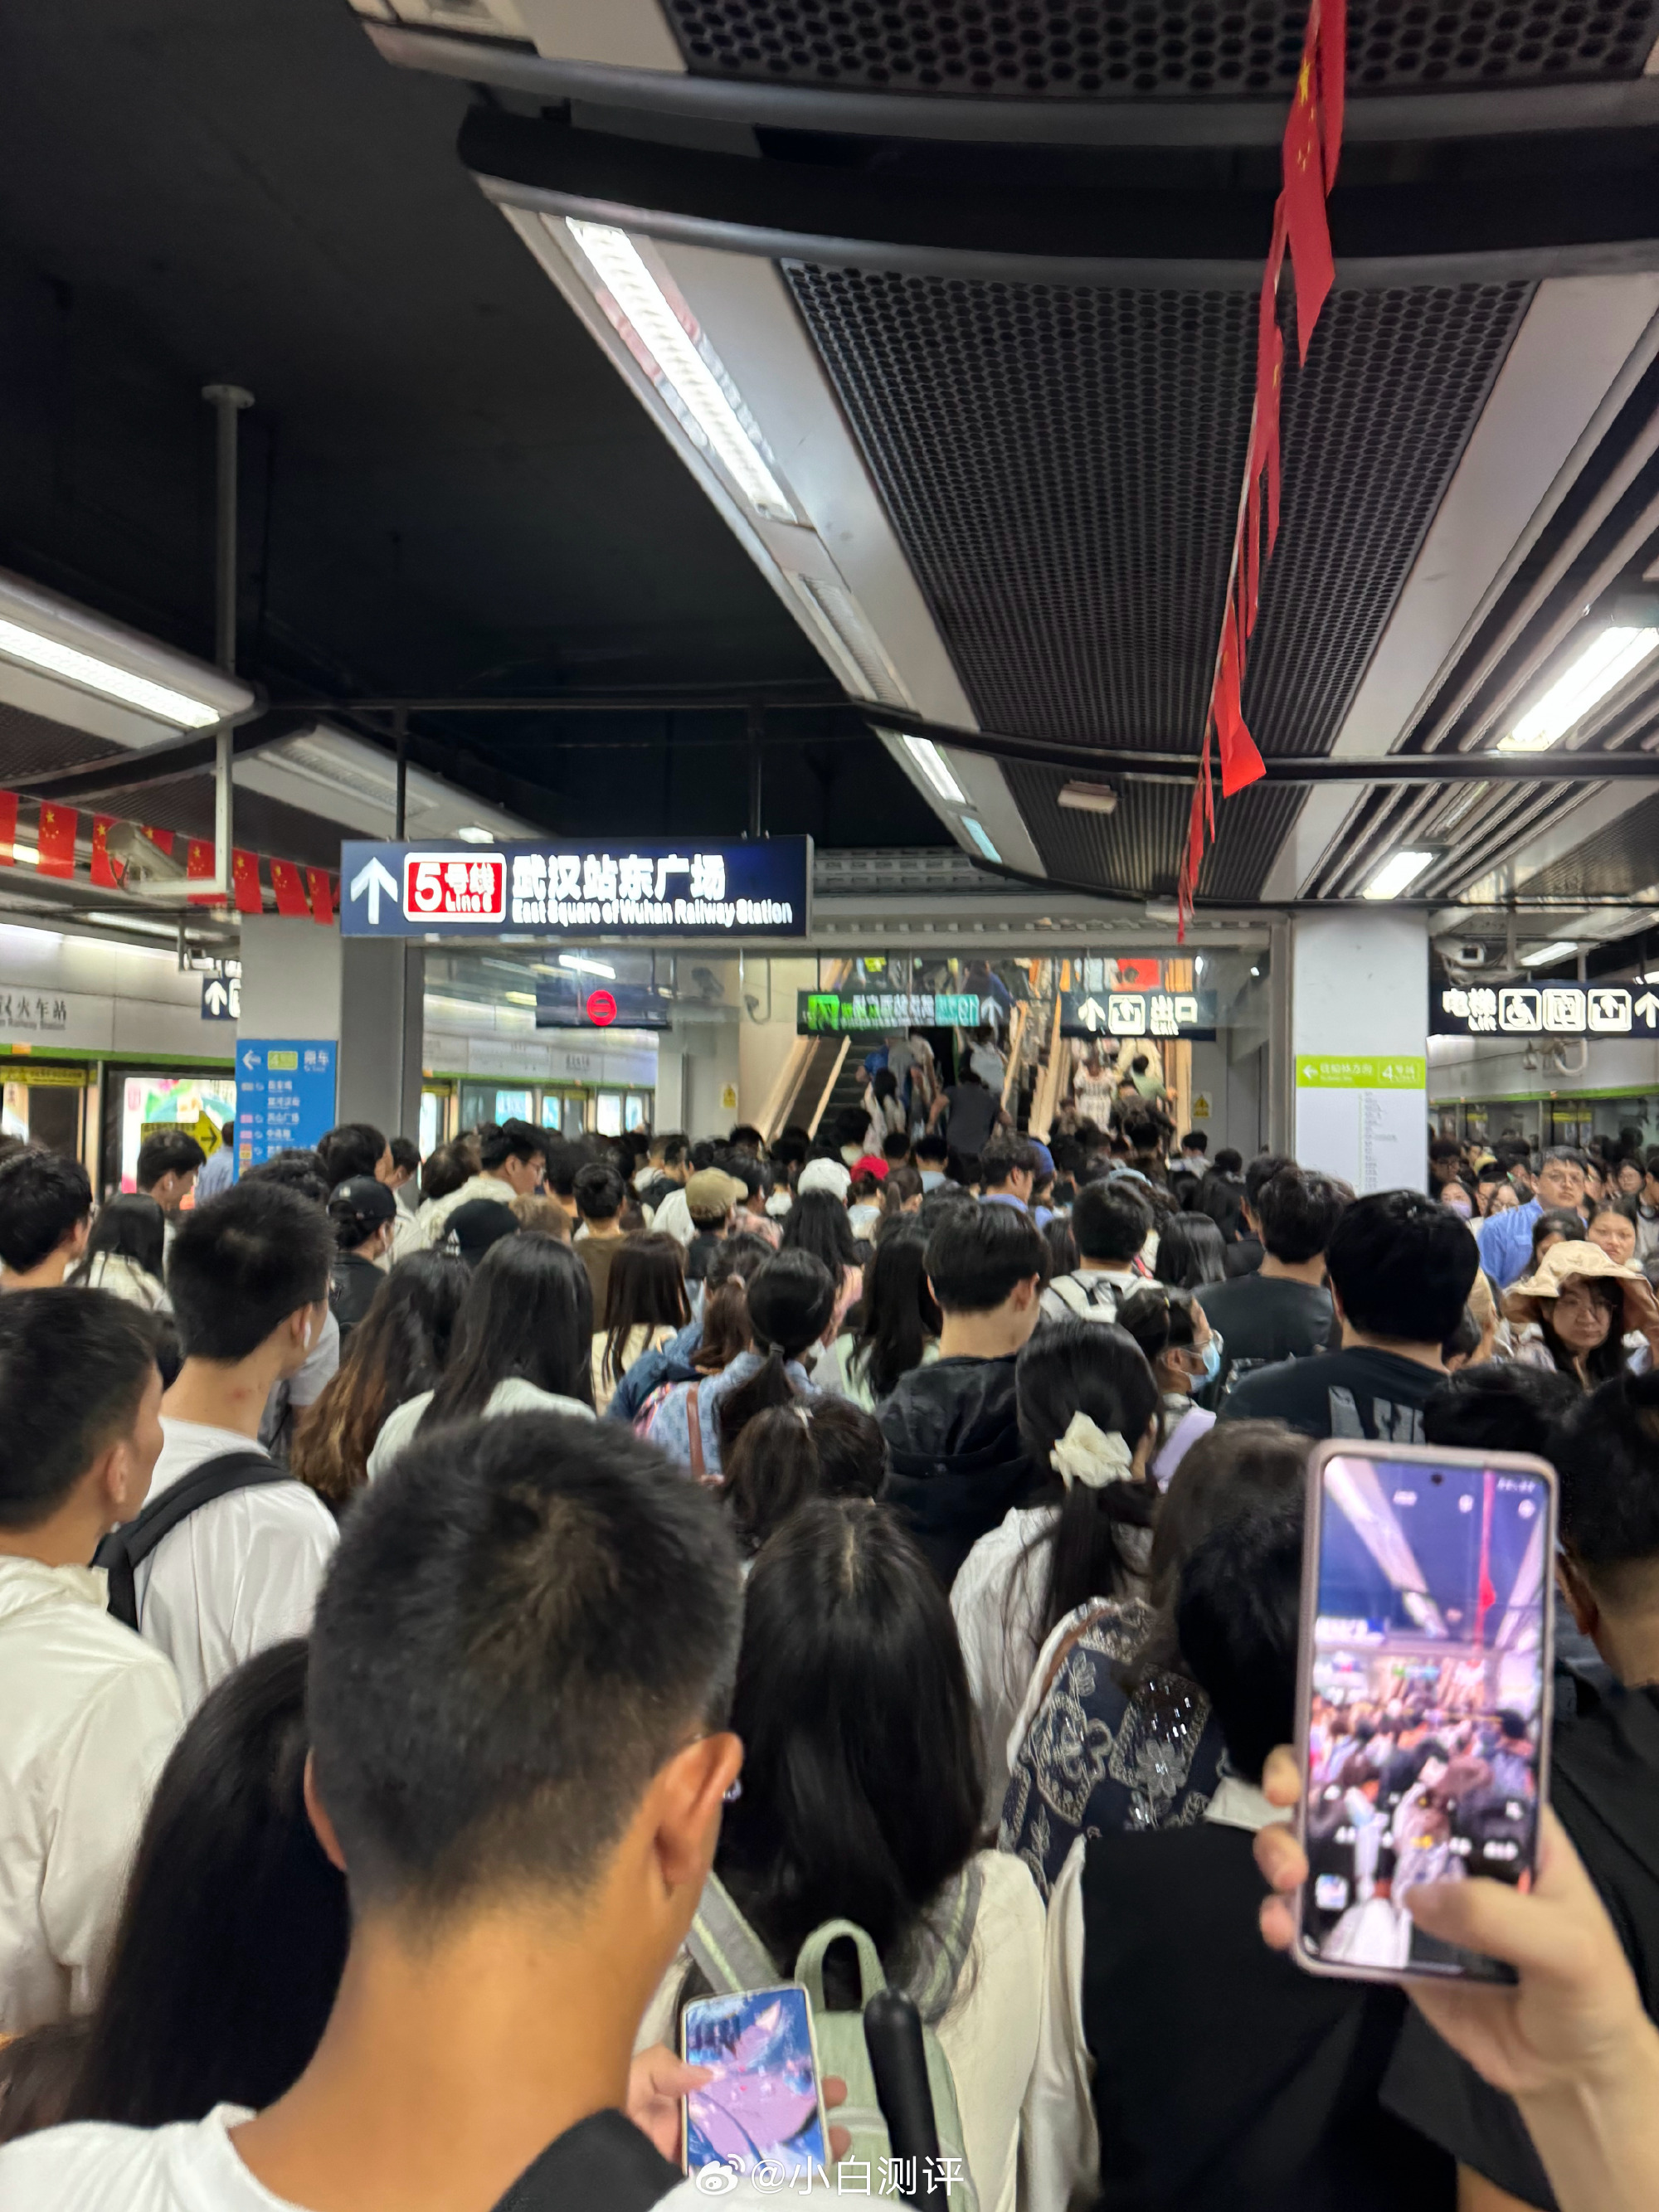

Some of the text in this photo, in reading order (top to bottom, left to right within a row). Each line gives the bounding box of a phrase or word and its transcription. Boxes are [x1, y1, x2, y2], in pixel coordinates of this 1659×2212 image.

[513, 853, 726, 901] 武汉站东广场
[513, 899, 793, 927] East Square of Wuhan Railway Station
